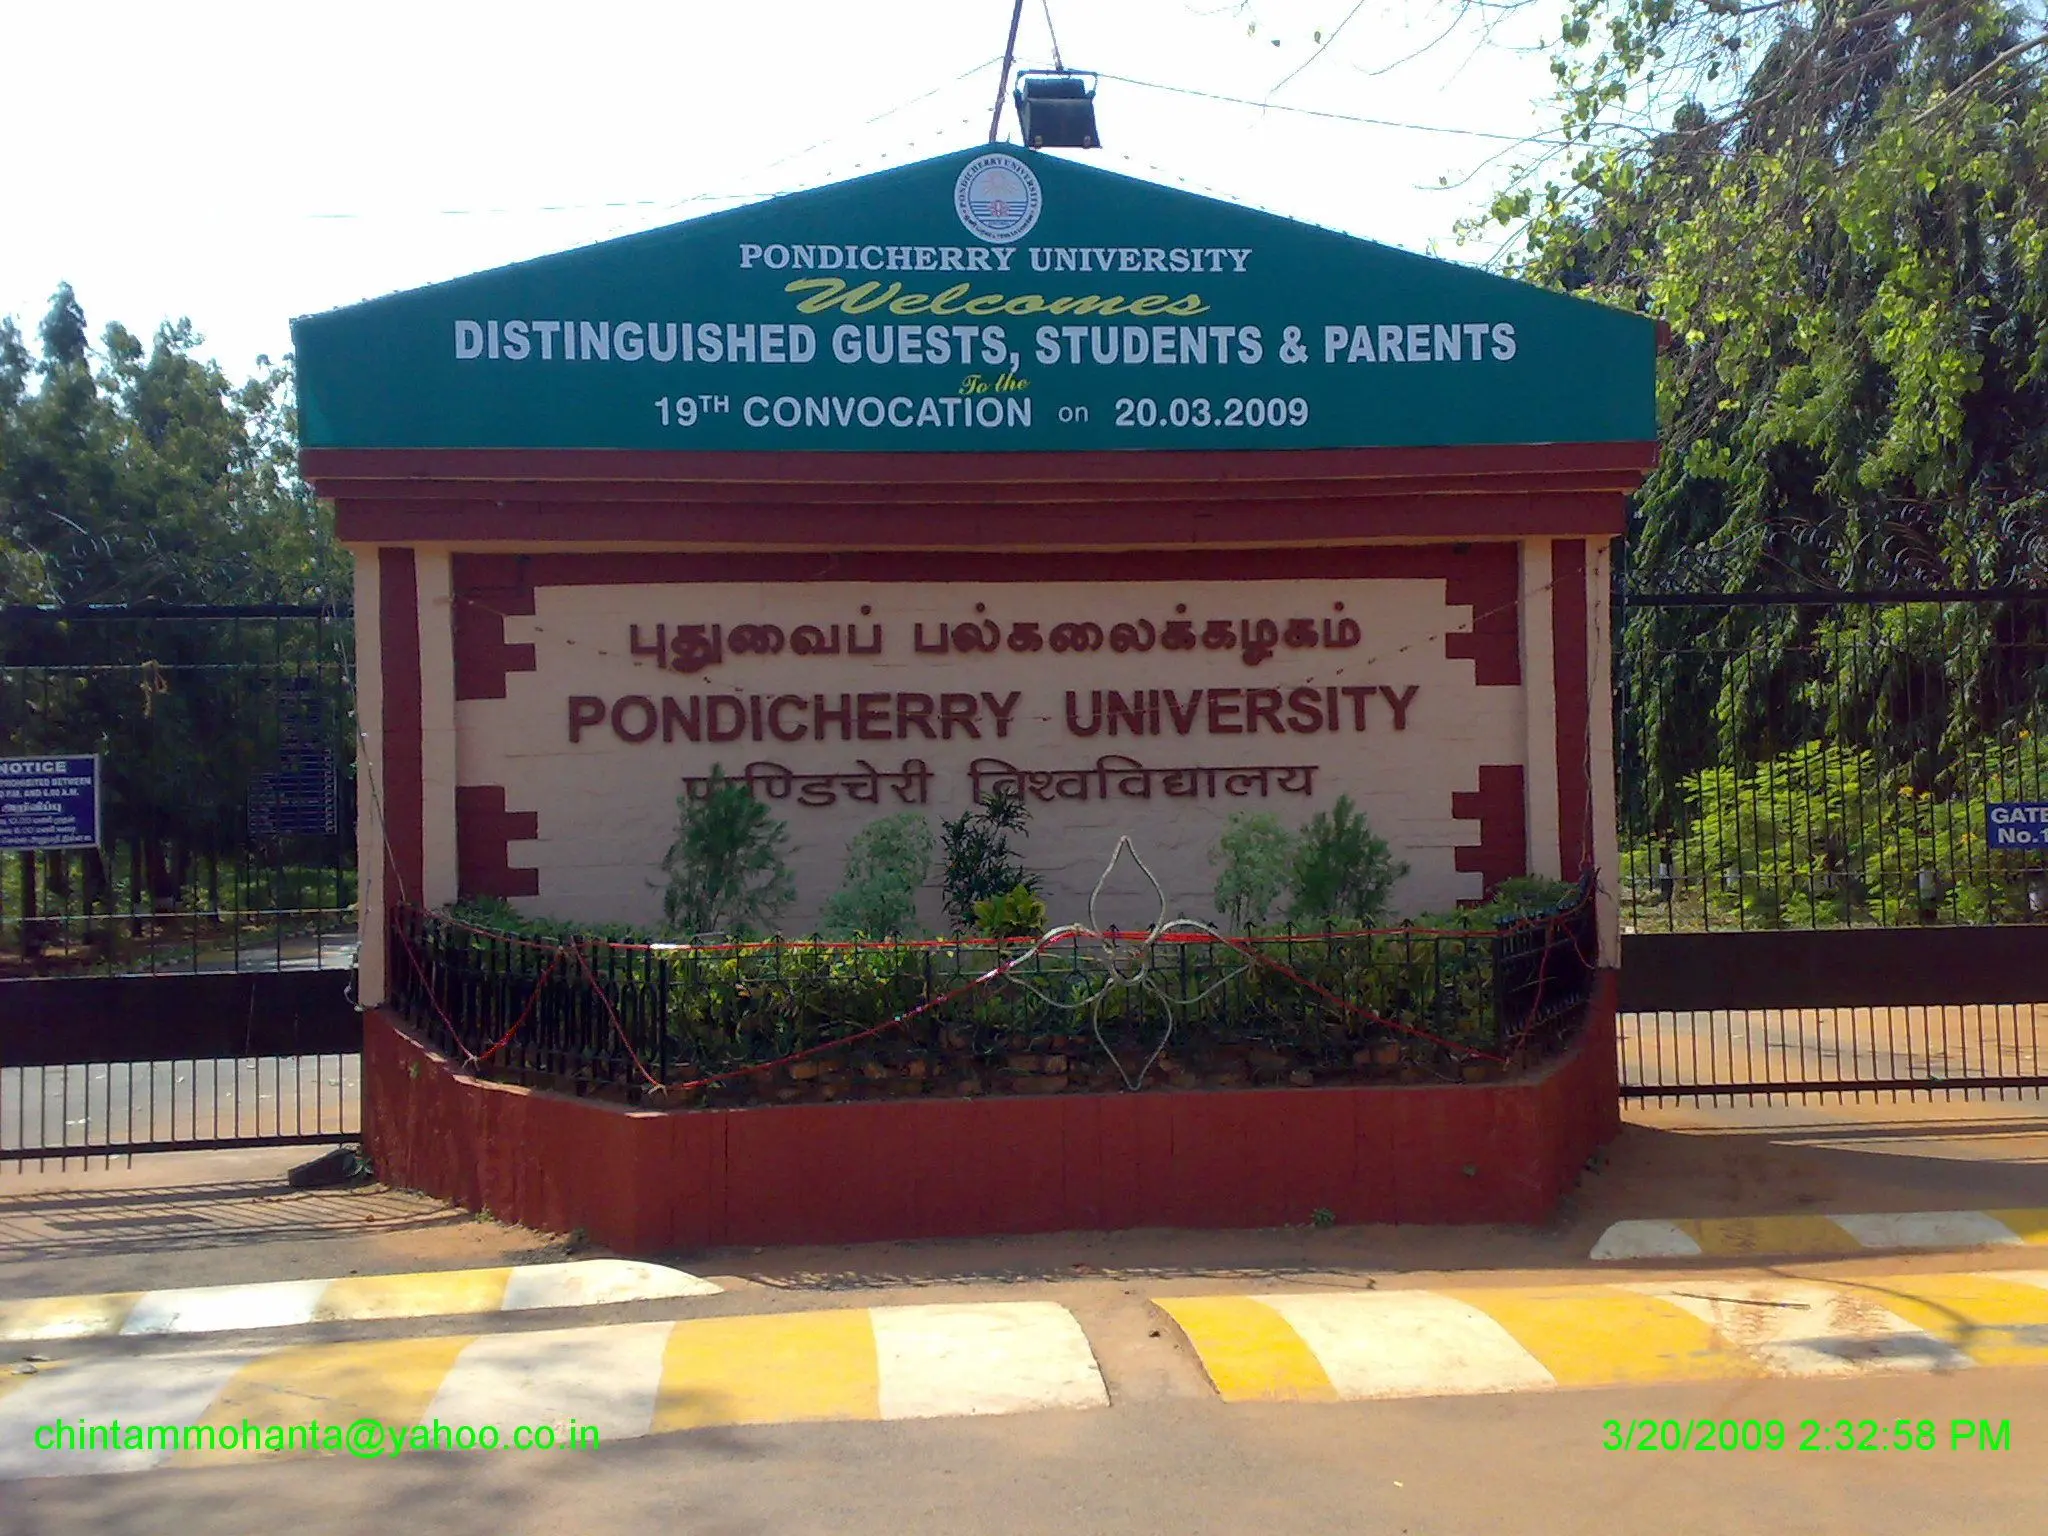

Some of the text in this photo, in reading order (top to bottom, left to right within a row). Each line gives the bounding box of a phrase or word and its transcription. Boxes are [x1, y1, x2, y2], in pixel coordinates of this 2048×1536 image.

[739, 243, 1252, 273] PONDICHERRY UNIVERSITY
[784, 277, 1210, 316] Welcomes
[454, 320, 1518, 373] DISTINGUISHED GUESTS, STUDENTS & PARENTS
[958, 372, 1031, 395] To the
[654, 394, 1310, 429] 19TH CONVOCATION on 20.03.2009
[629, 601, 1362, 674] புதுவைப் பல்கலைக்கழகம்
[568, 684, 1420, 743] PONDICHERRY UNIVERSITY
[0, 761, 67, 775] NOTICE
[681, 753, 1319, 807] पण्डिचेरी विश्वविद्यालय
[1990, 807, 2048, 824] GATE
